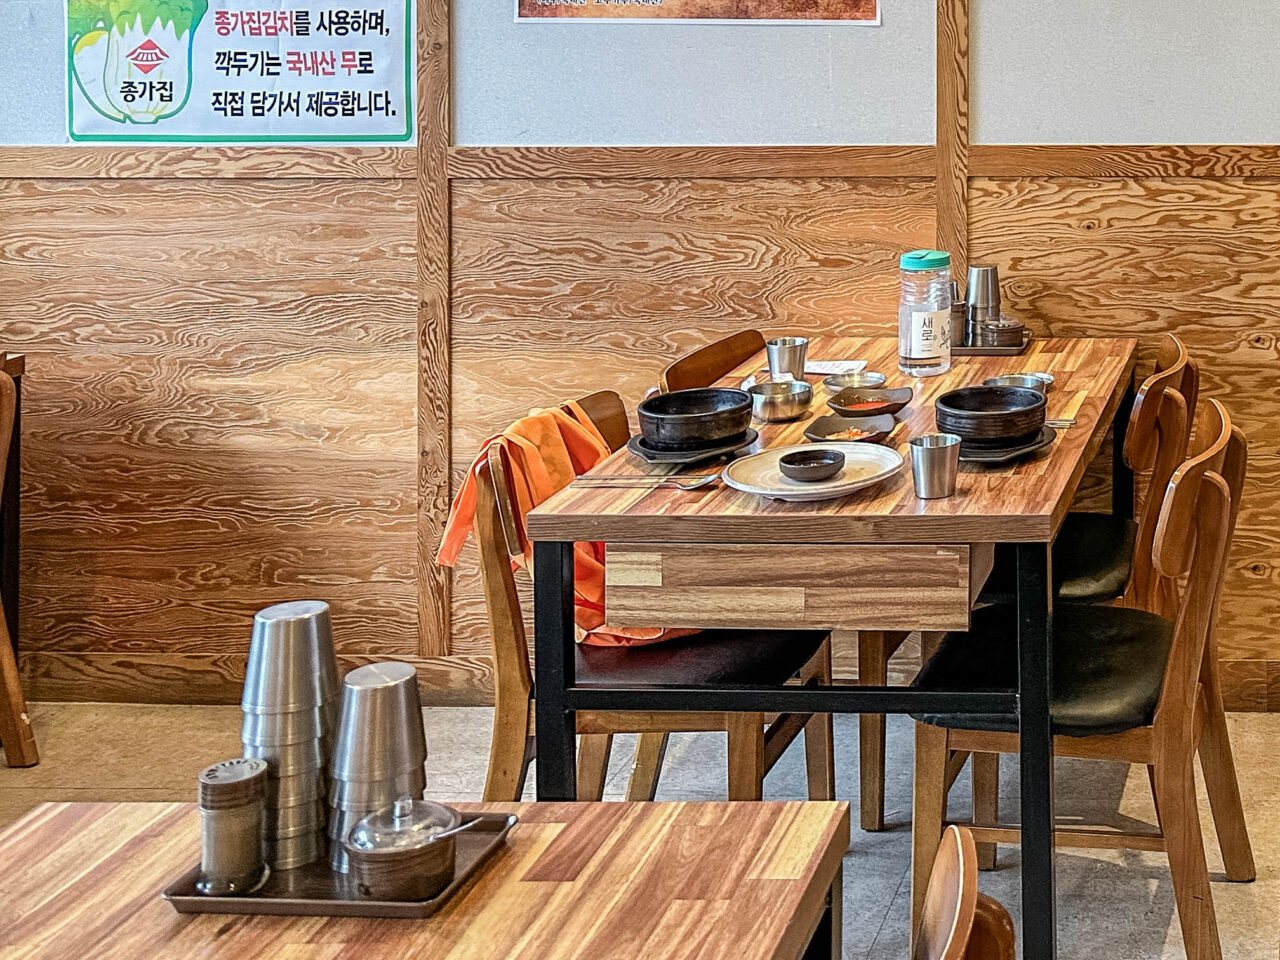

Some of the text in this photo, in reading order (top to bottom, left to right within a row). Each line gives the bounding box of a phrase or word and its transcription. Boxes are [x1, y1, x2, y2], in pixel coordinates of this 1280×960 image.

[214, 9, 390, 37] 종가집김치를 사용하며,
[214, 50, 374, 76] 깍두기는 국내산 무로
[119, 81, 173, 102] 종가집
[211, 91, 397, 117] 직접 담가서 제공합니다.
